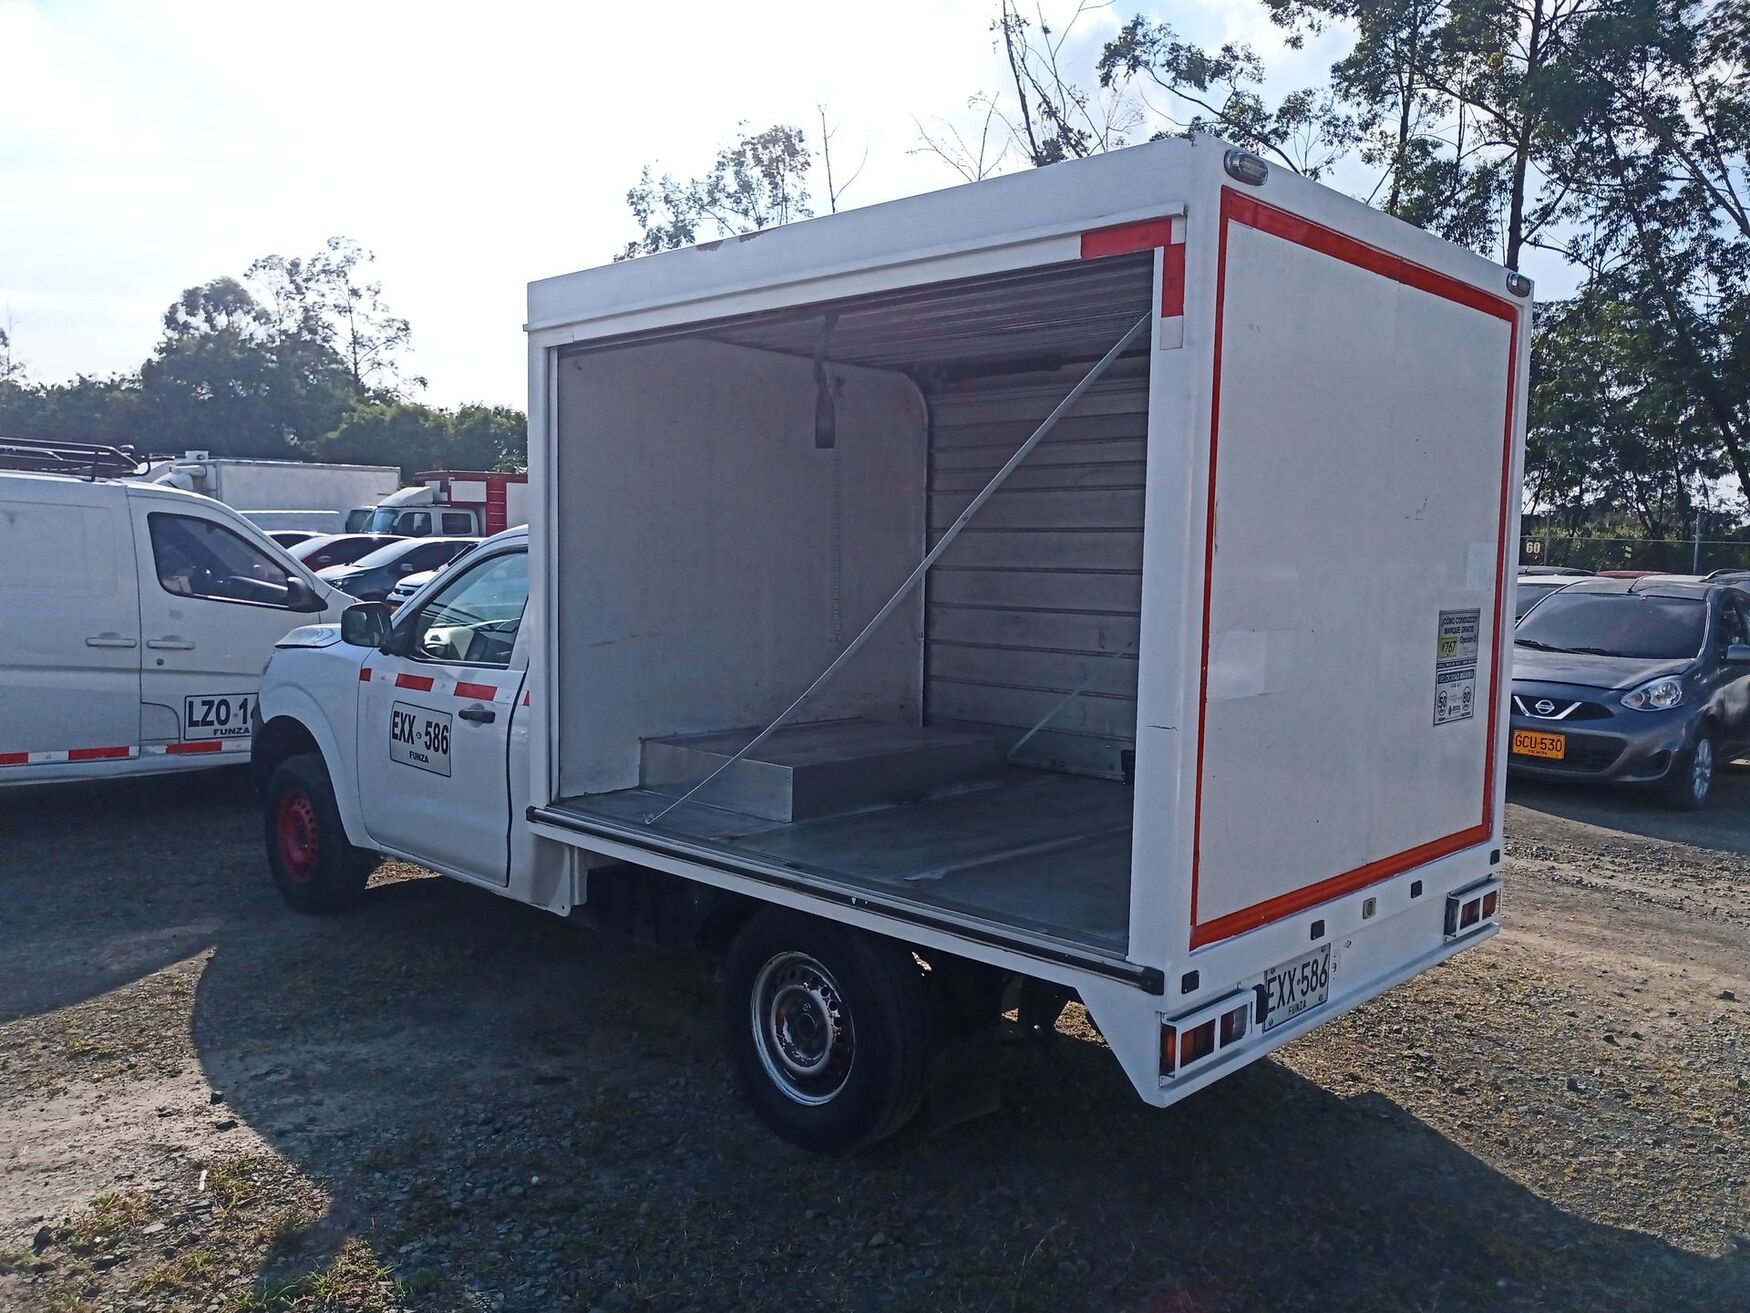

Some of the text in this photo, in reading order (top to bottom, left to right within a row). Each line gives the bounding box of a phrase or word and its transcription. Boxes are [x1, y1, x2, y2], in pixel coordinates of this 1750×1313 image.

[1526, 541, 1541, 553] 60
[213, 728, 250, 736] FUNZA
[409, 751, 429, 764] FUNZA
